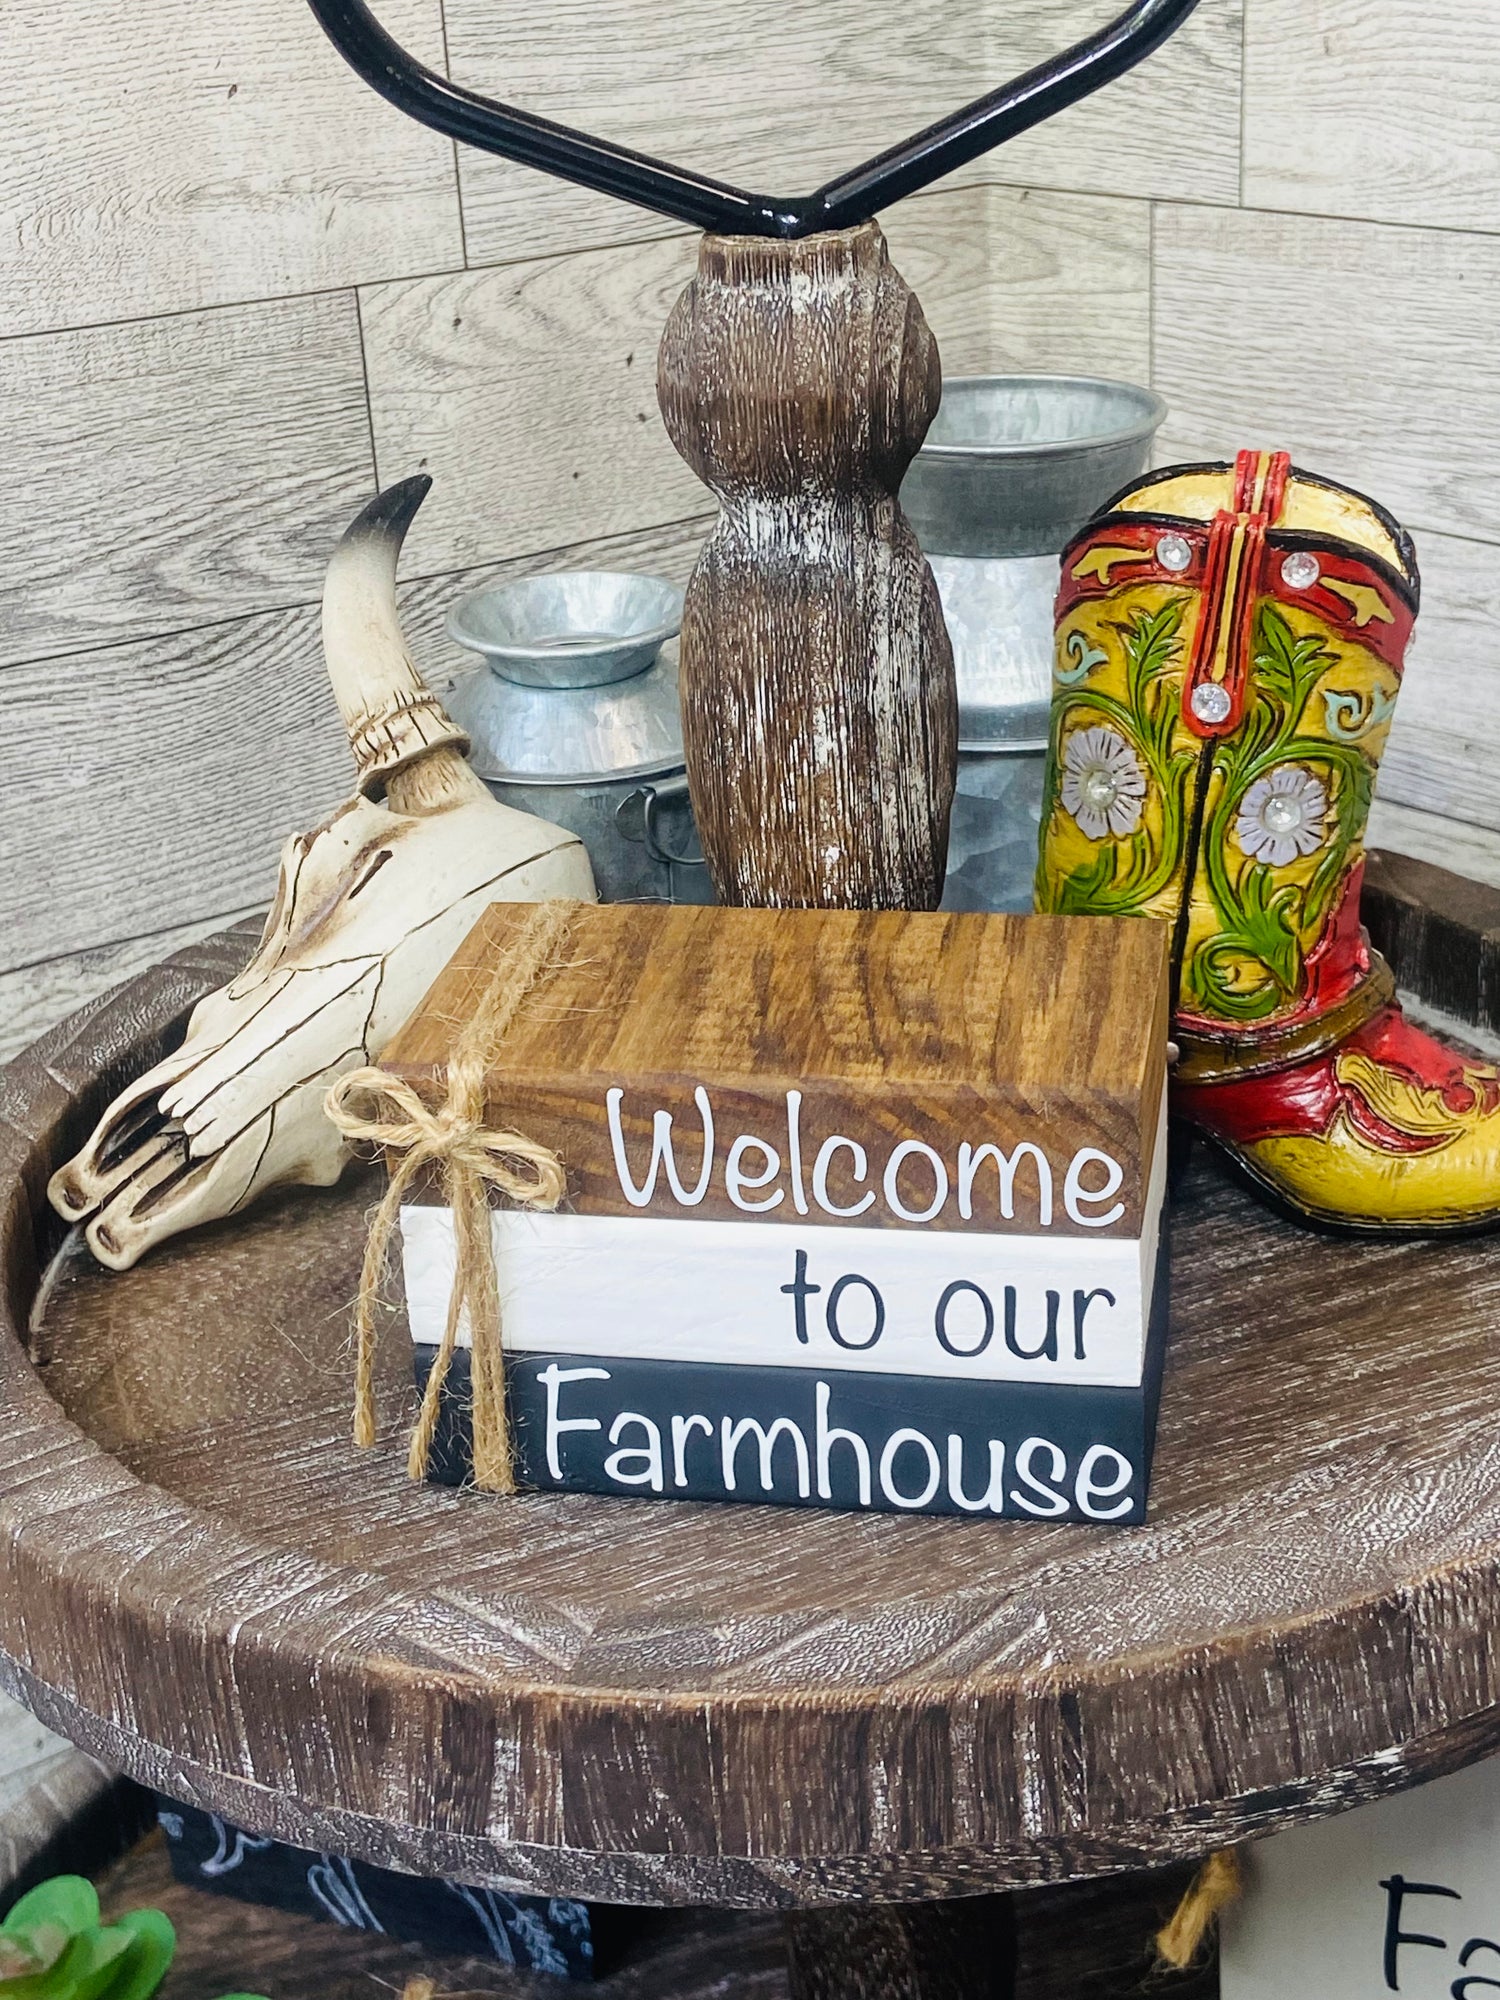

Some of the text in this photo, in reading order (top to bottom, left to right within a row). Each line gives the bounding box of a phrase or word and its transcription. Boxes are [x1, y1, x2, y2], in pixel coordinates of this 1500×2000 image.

[606, 1085, 1125, 1227] Welcome
[780, 1249, 1116, 1362] to our
[536, 1363, 1134, 1521] Farmhouse
